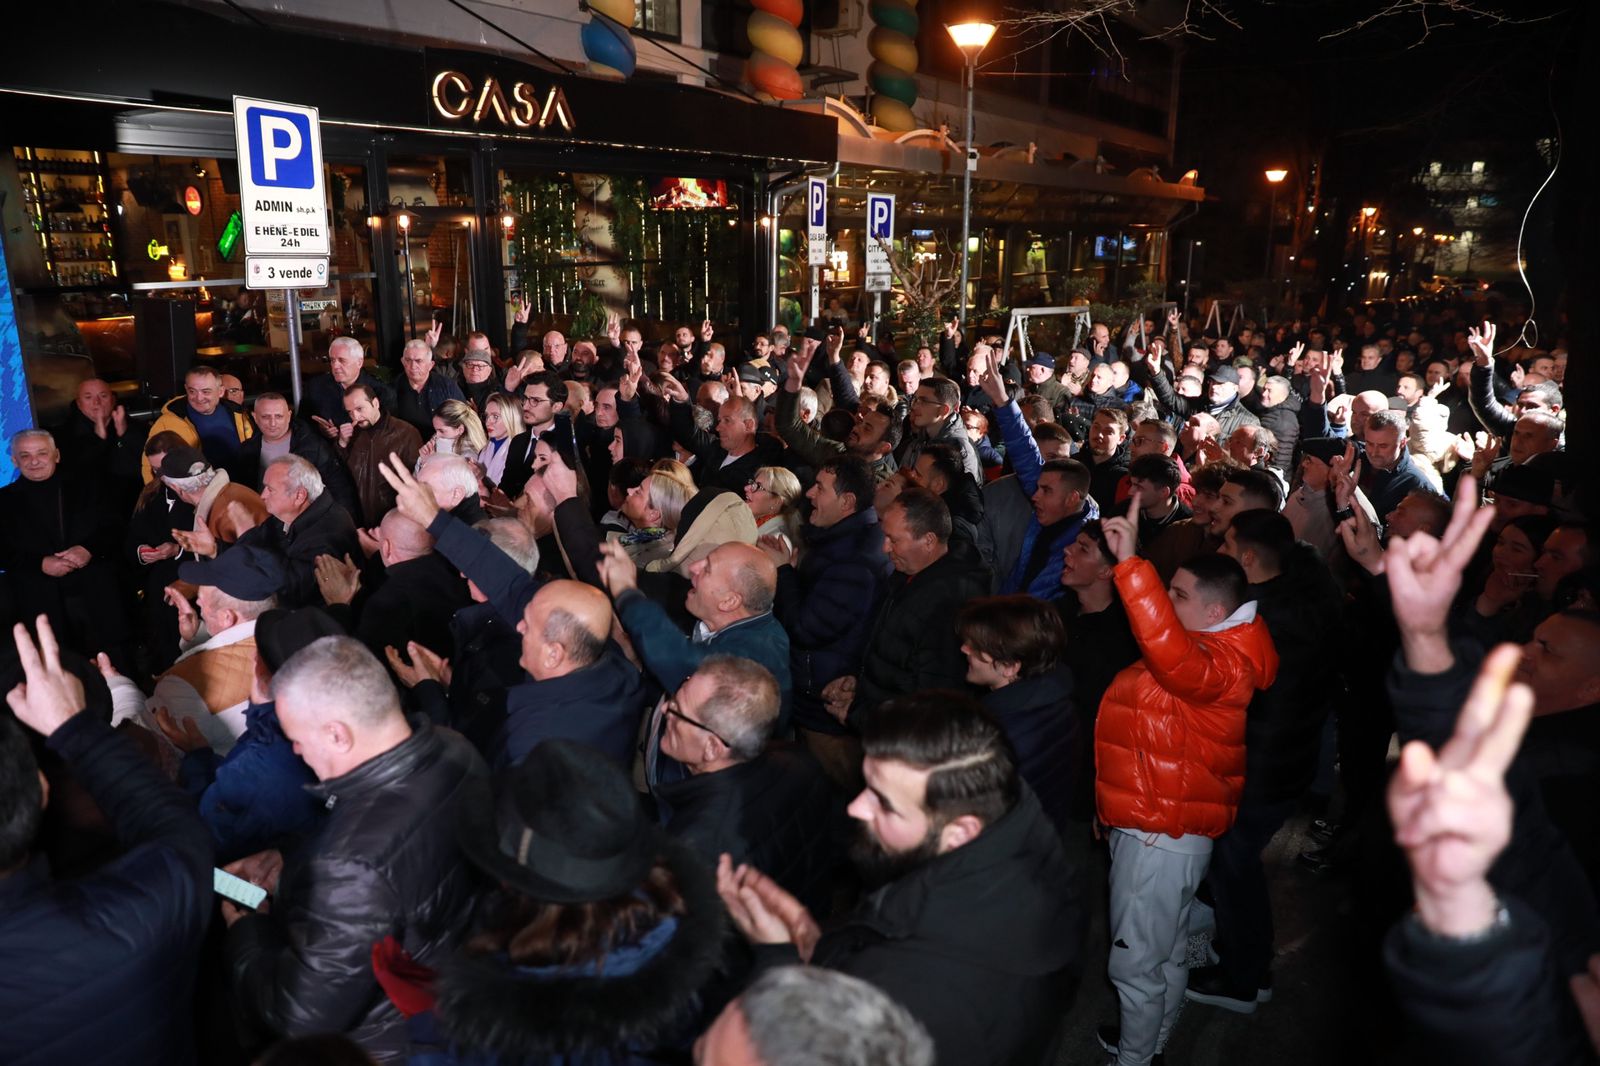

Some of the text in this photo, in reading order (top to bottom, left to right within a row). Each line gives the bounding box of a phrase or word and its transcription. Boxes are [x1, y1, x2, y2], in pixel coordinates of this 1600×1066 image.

[432, 71, 576, 130] CASA
[259, 114, 303, 181] P
[255, 199, 293, 213] ADMIN
[812, 185, 823, 223] P
[874, 200, 889, 235] P
[254, 225, 261, 236] E
[300, 227, 320, 237] DIEL
[268, 266, 313, 279] 3 vende
